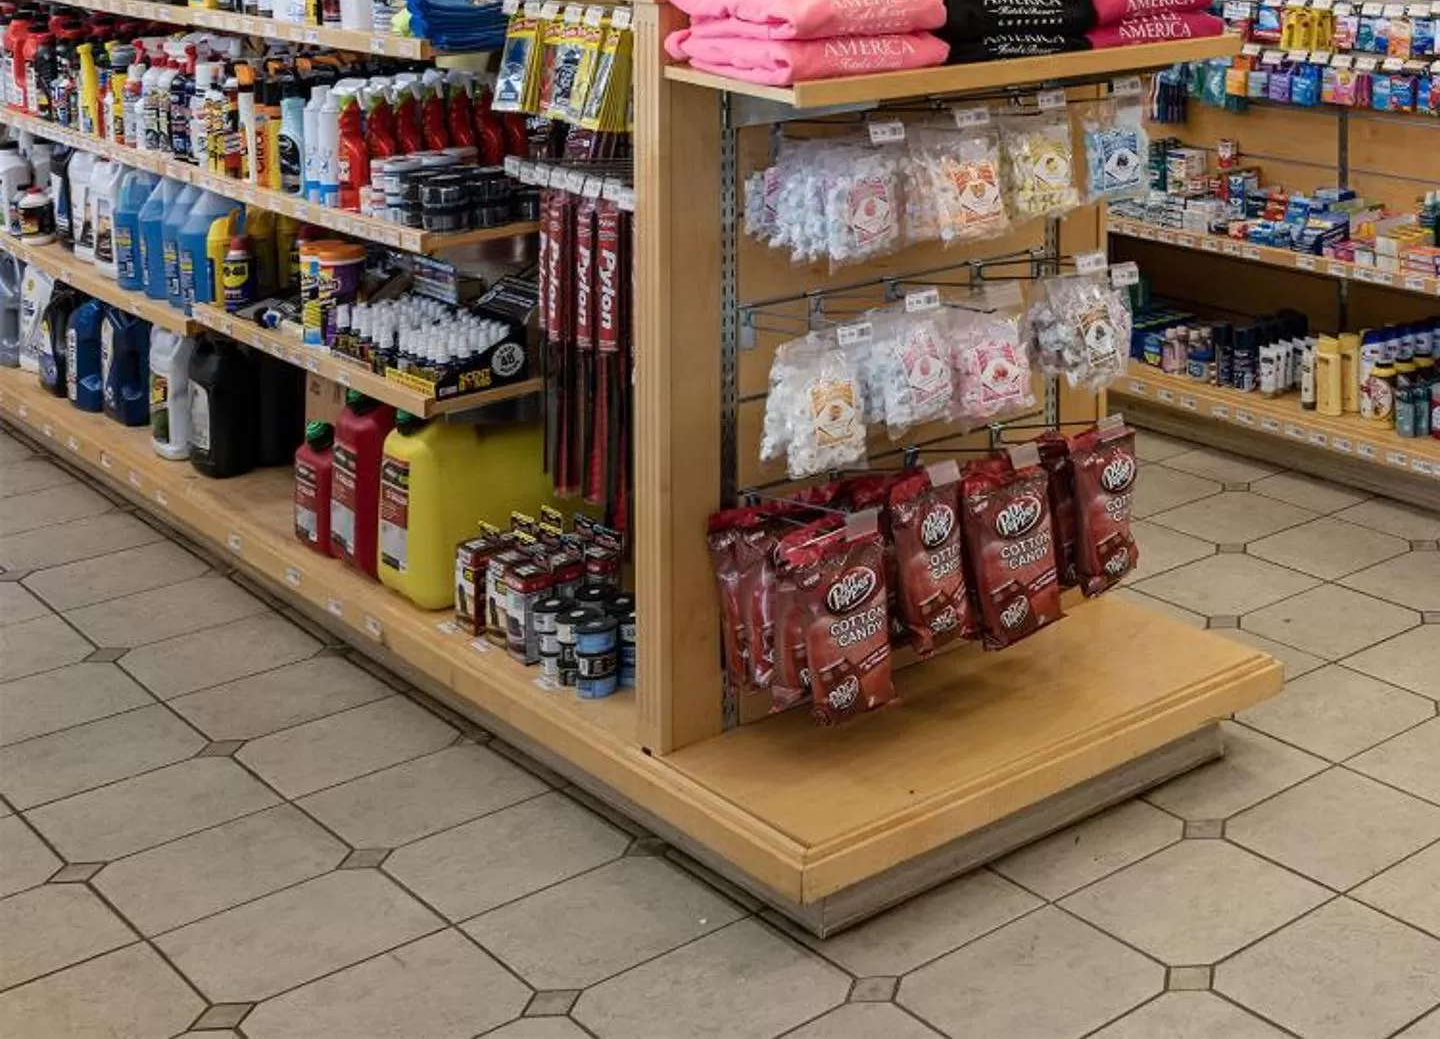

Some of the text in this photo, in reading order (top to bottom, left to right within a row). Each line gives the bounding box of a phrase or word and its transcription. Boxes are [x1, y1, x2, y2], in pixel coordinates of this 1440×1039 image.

[1119, 22, 1192, 39] AMERICA
[824, 39, 916, 57] AMERICA
[577, 245, 591, 326] Pylon
[599, 249, 616, 330] Pylon
[831, 607, 886, 636] COTTON
[838, 621, 882, 646] CANDY
